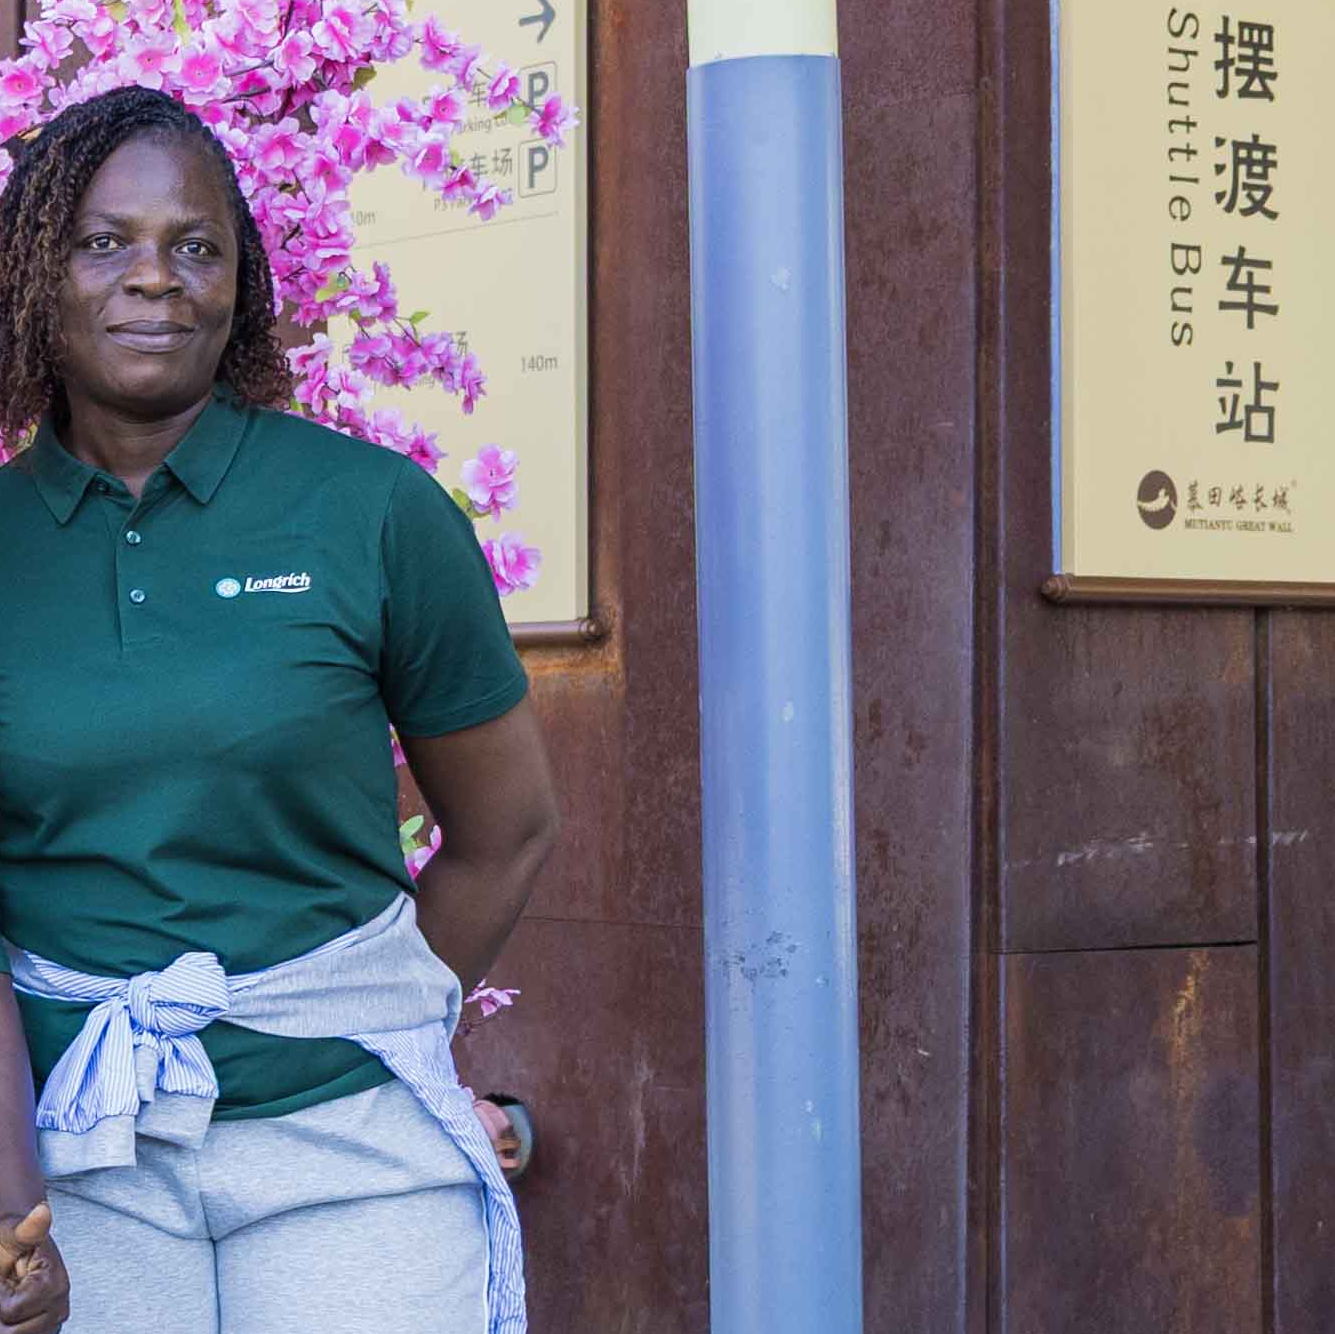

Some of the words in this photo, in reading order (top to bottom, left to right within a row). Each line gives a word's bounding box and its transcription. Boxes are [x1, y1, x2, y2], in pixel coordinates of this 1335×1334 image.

[1167, 7, 1201, 223] Shuttle
[1214, 14, 1280, 444] 摆渡车站
[1170, 241, 1202, 348] Bus
[521, 354, 559, 373] 140m
[245, 572, 312, 593] Longrich
